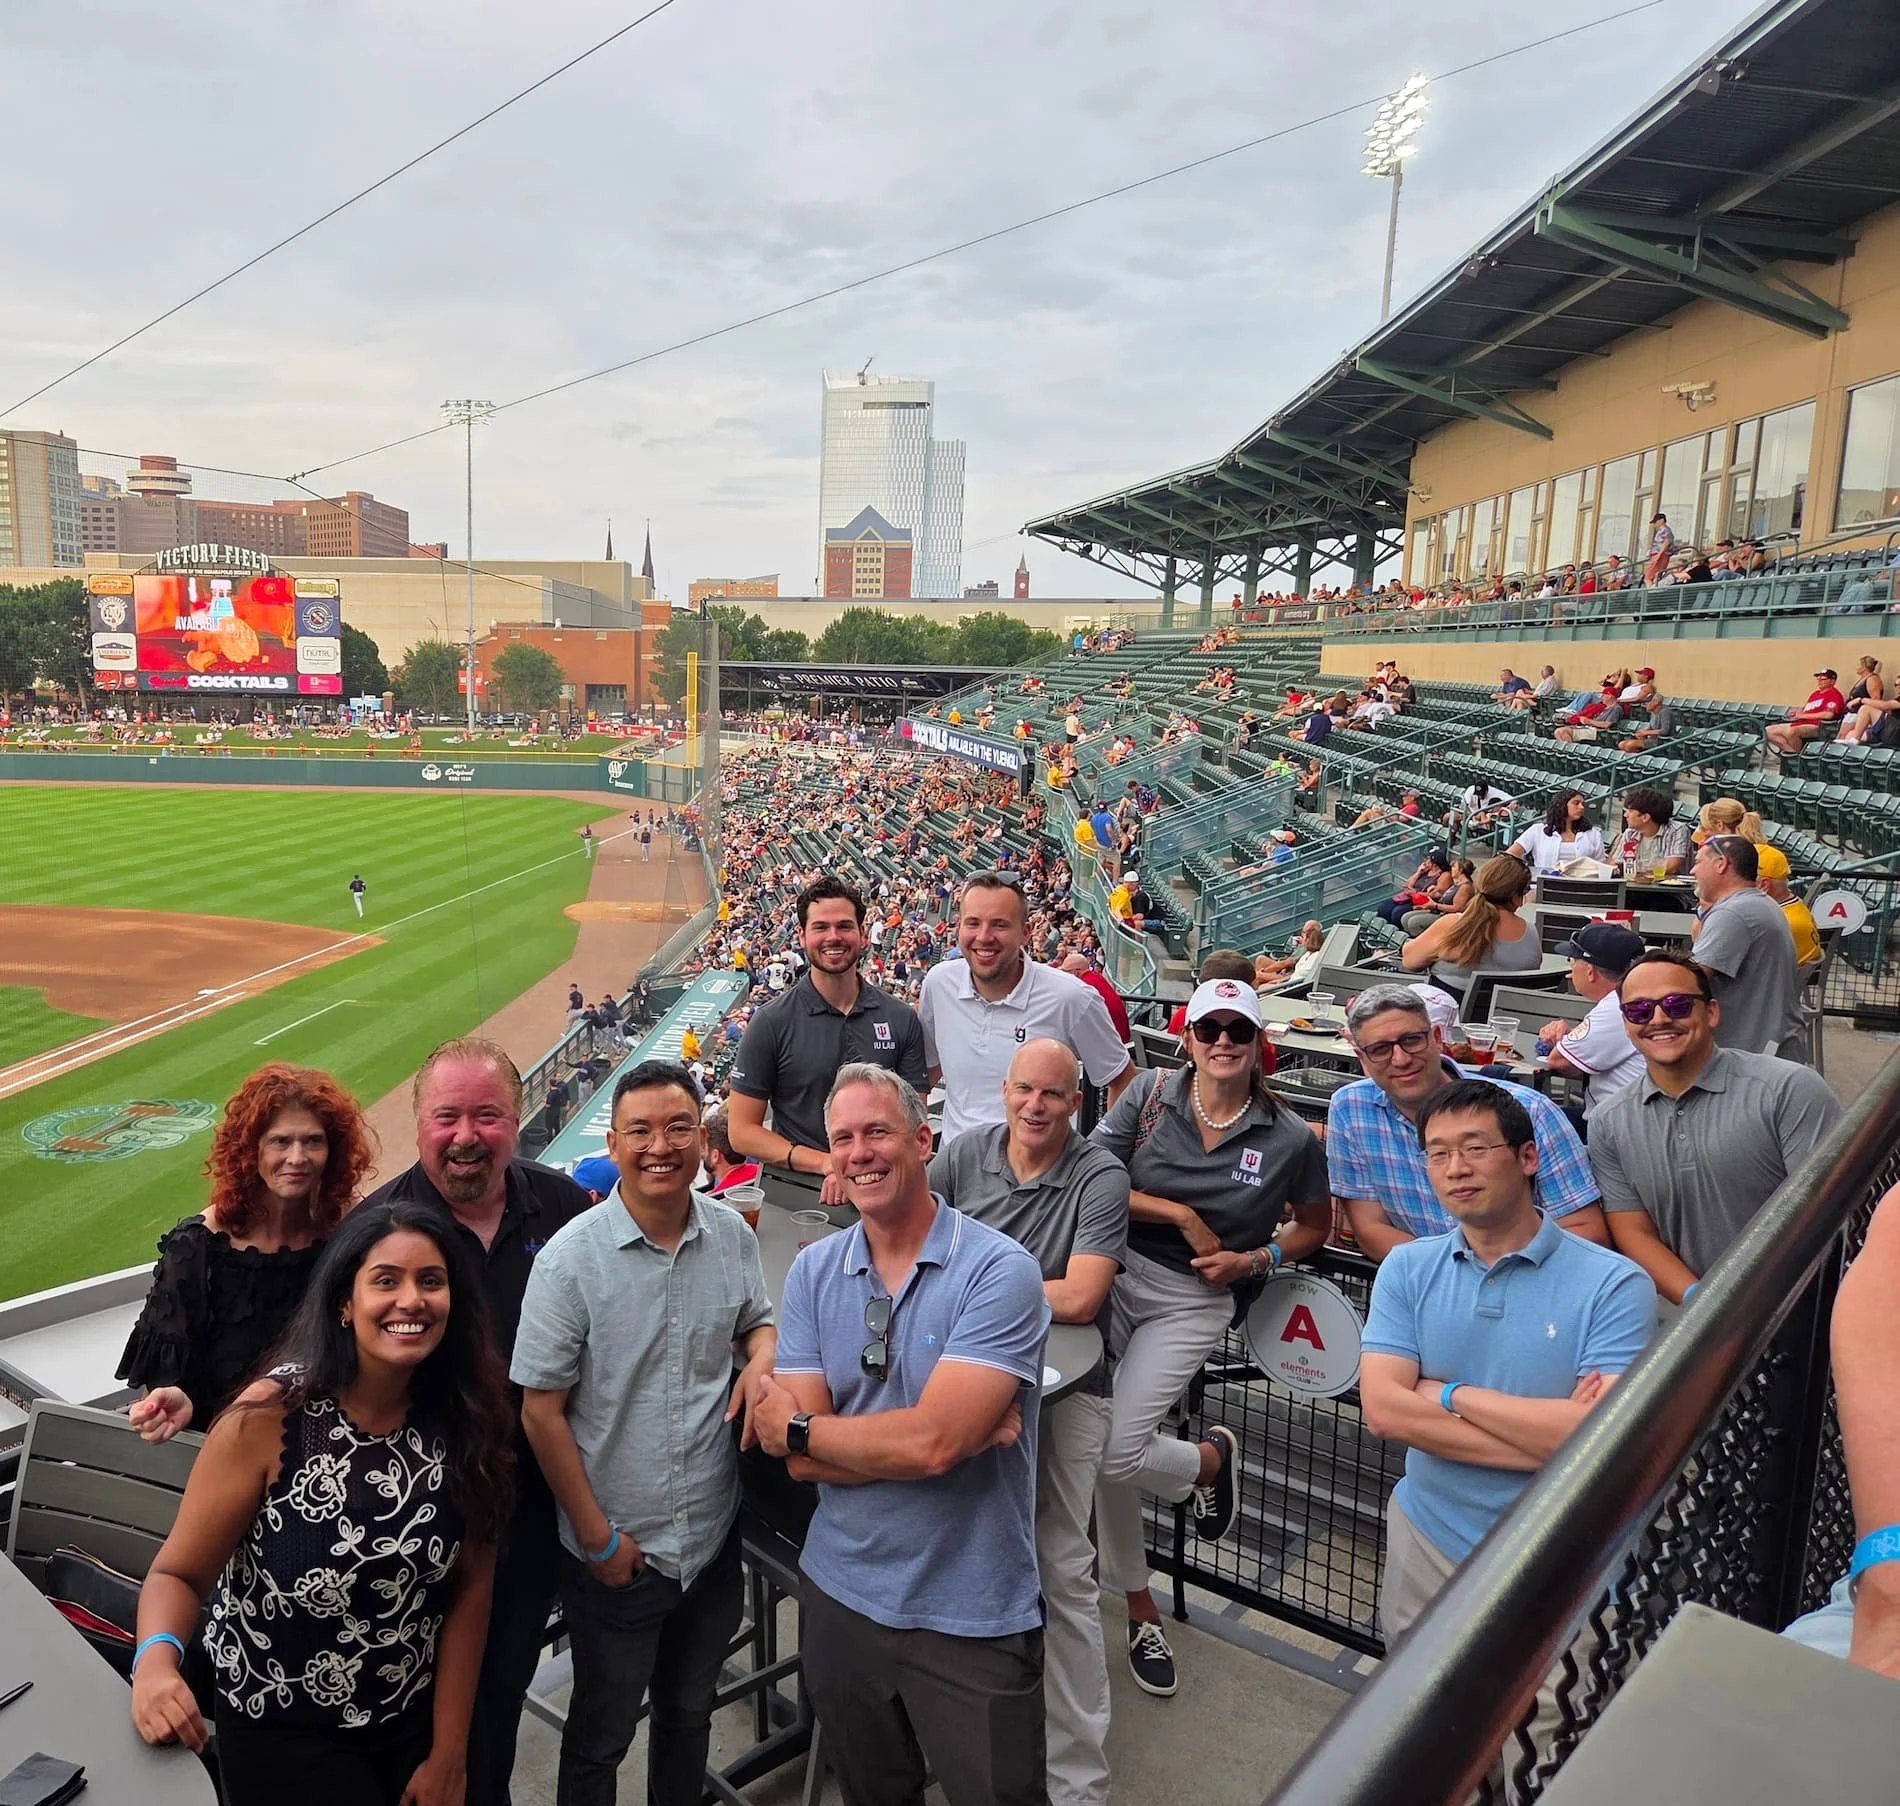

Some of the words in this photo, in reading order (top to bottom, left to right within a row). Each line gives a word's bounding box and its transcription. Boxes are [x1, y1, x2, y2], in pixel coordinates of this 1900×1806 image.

[156, 543, 219, 569] VICTORY
[224, 544, 269, 572] FIELD
[187, 675, 288, 689] COCKTAILS
[794, 673, 854, 687] PREMIER
[854, 676, 898, 688] PATIO
[912, 721, 948, 752] COCKTAILS
[973, 742, 980, 758] IN
[980, 744, 992, 762] THE
[1828, 902, 1848, 918] A
[775, 969, 781, 977] 5
[675, 1001, 717, 1024] FIELD
[873, 1041, 881, 1050] IU
[882, 1041, 896, 1050] LAB
[1231, 1170, 1242, 1181] IU
[1242, 1173, 1262, 1187] LAB
[1289, 1282, 1318, 1296] ROW
[1280, 1303, 1326, 1352] A
[1280, 1361, 1326, 1379] elements
[1296, 1376, 1312, 1385] CLUB
